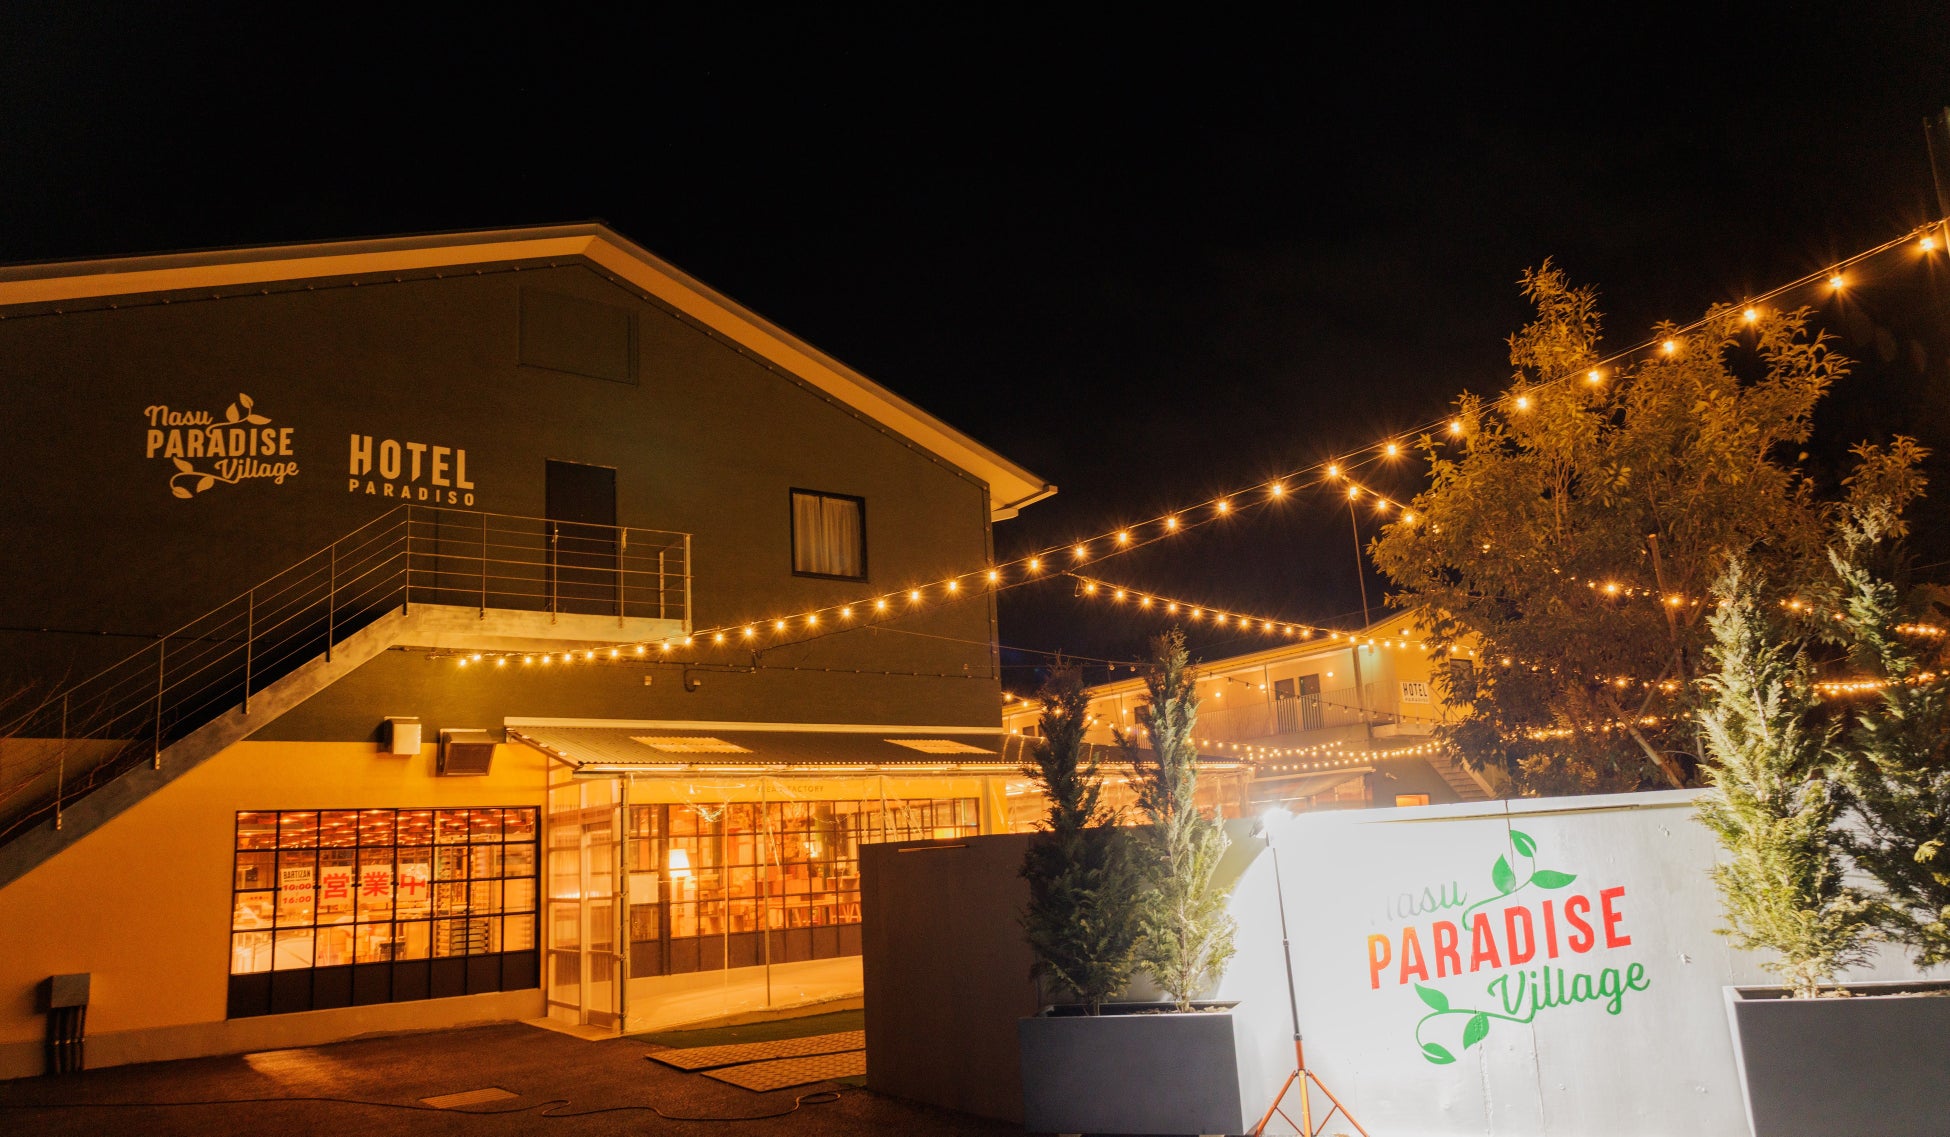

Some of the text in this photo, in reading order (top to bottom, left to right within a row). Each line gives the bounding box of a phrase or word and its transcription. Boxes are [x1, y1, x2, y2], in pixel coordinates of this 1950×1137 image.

[143, 404, 214, 427] Nasu
[146, 427, 295, 459] PARADISE
[214, 458, 300, 485] Village
[348, 433, 475, 490] HOTEL
[348, 478, 476, 507] PARADISO
[1402, 682, 1428, 697] HOTEL
[282, 883, 312, 891] 10:00
[283, 869, 311, 880] BARTIZAN
[322, 871, 426, 900] 営業中
[282, 896, 312, 904] 16:00
[1367, 886, 1632, 990] PARADISE
[1487, 962, 1651, 1020] Village
